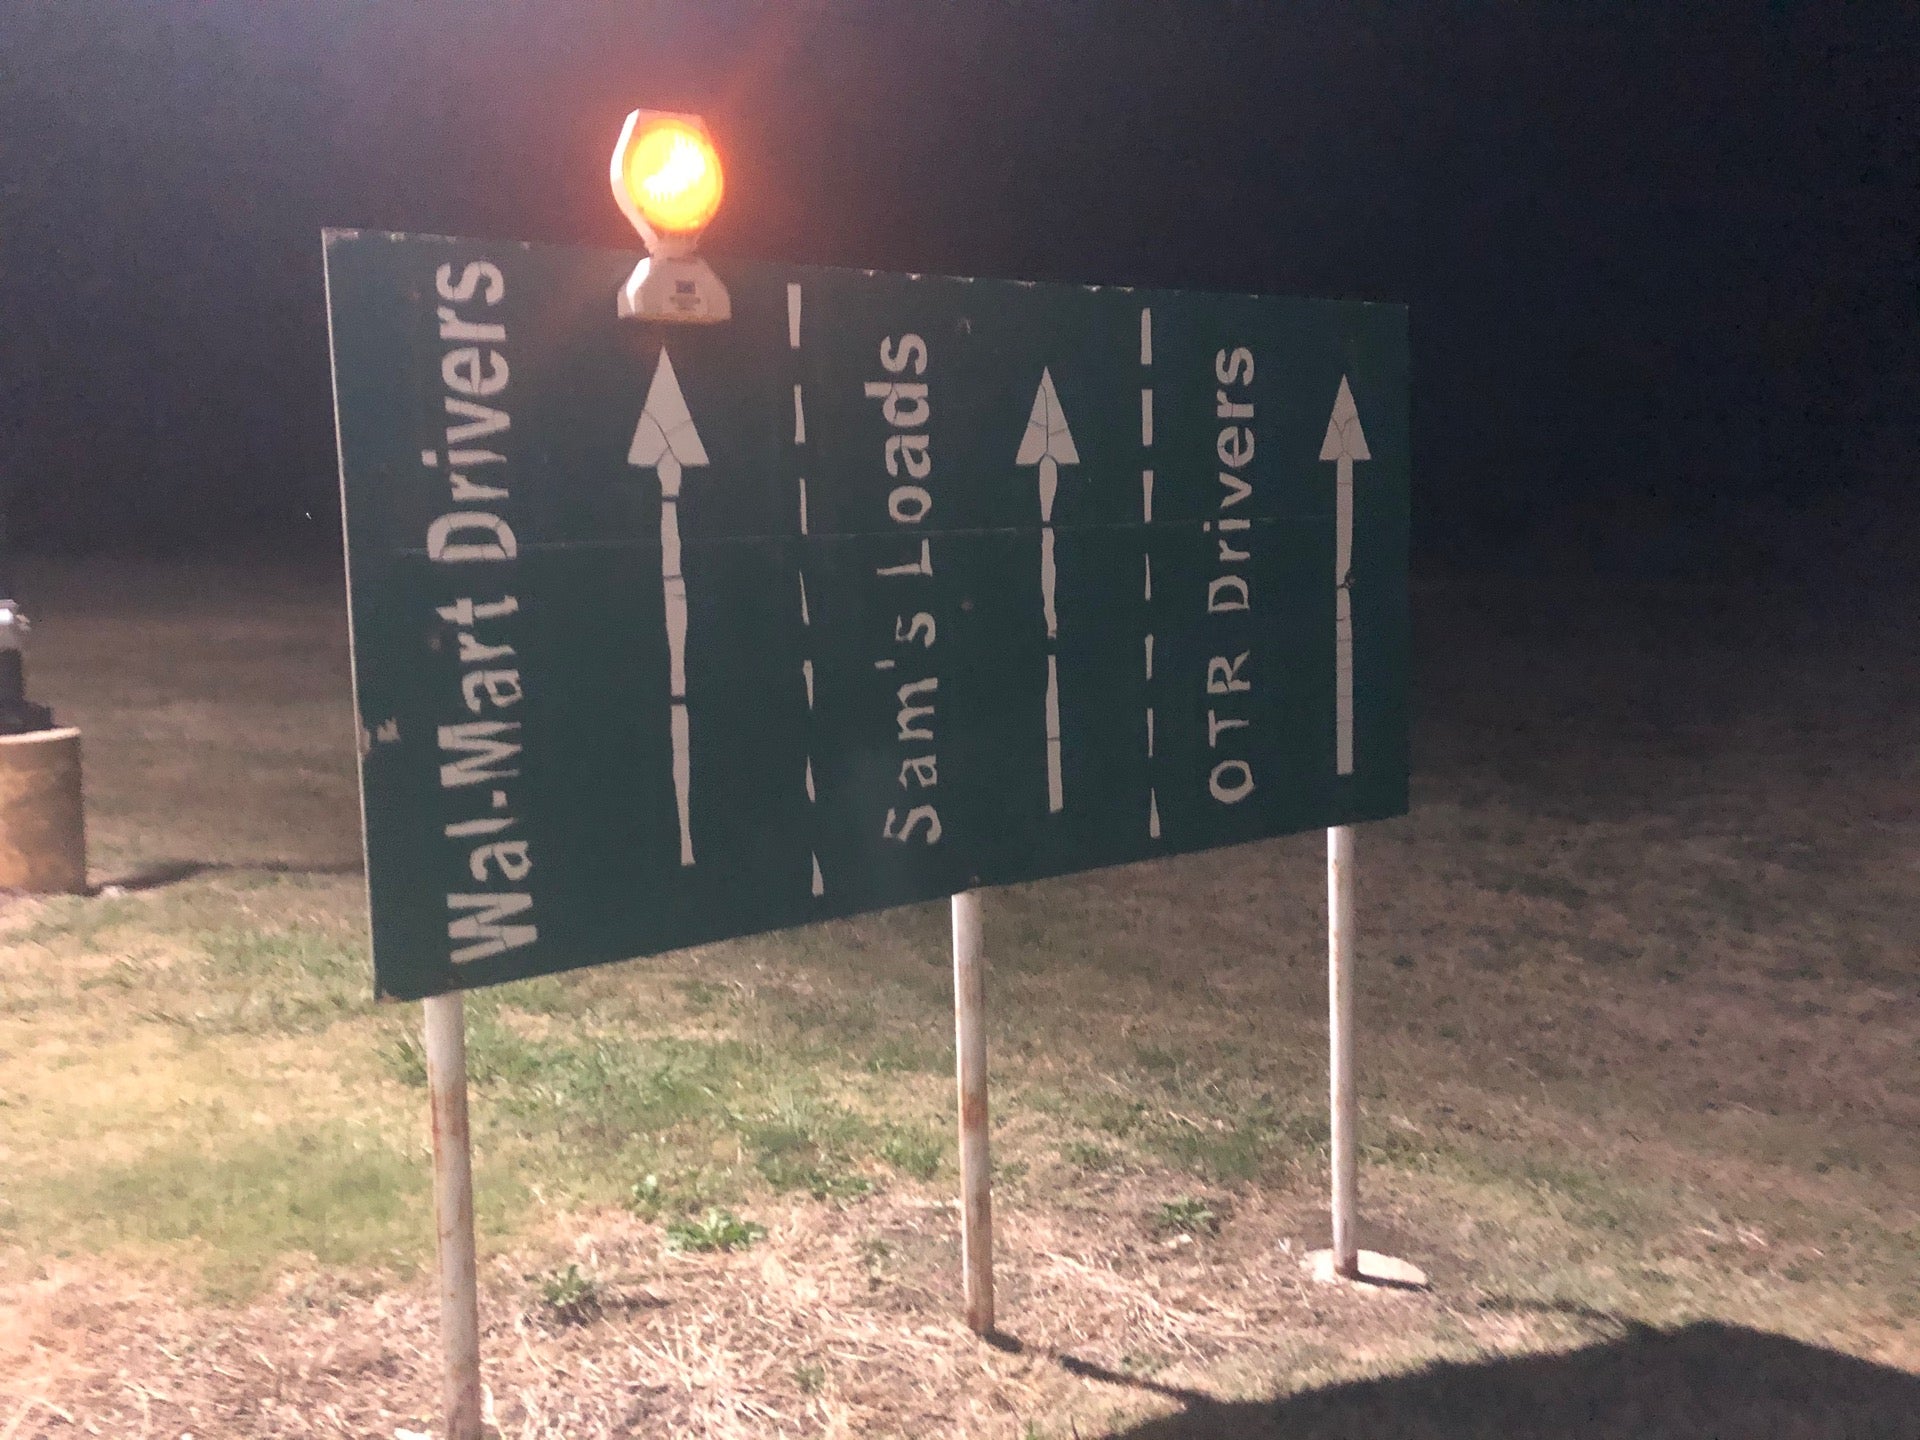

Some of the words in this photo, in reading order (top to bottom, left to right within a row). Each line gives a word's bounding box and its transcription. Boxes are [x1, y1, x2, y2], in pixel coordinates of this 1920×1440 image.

[420, 258, 519, 563] Drivers
[864, 332, 934, 577] Loads
[1203, 346, 1256, 613] Drivers
[435, 594, 540, 967] Wal-Mart
[875, 612, 943, 845] Sam's
[1208, 648, 1257, 805] OTR
